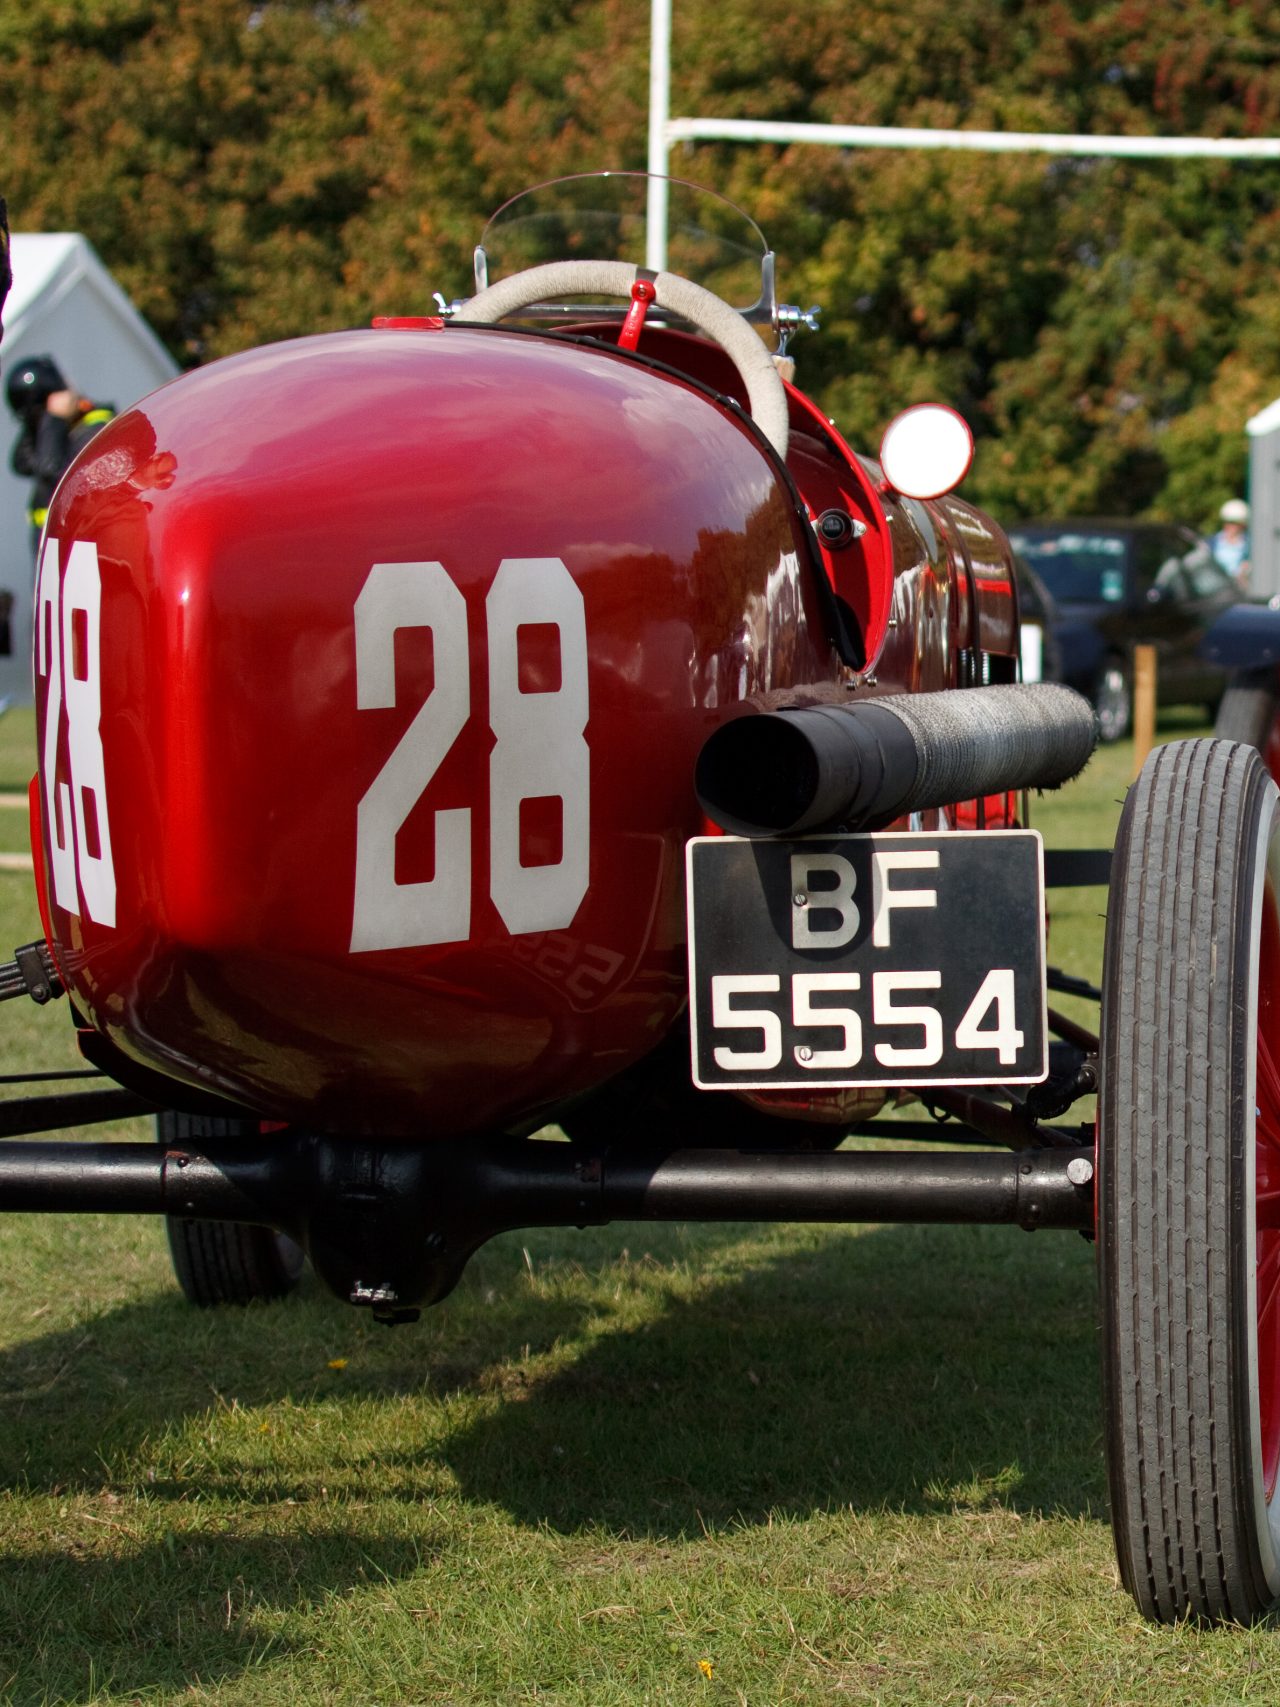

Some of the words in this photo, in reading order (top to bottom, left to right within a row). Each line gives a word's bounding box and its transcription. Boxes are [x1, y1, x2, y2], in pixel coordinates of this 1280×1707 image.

[35, 538, 116, 929] 28
[349, 557, 590, 954] 28
[711, 969, 1025, 1071] 5554
[791, 850, 941, 949] BF
